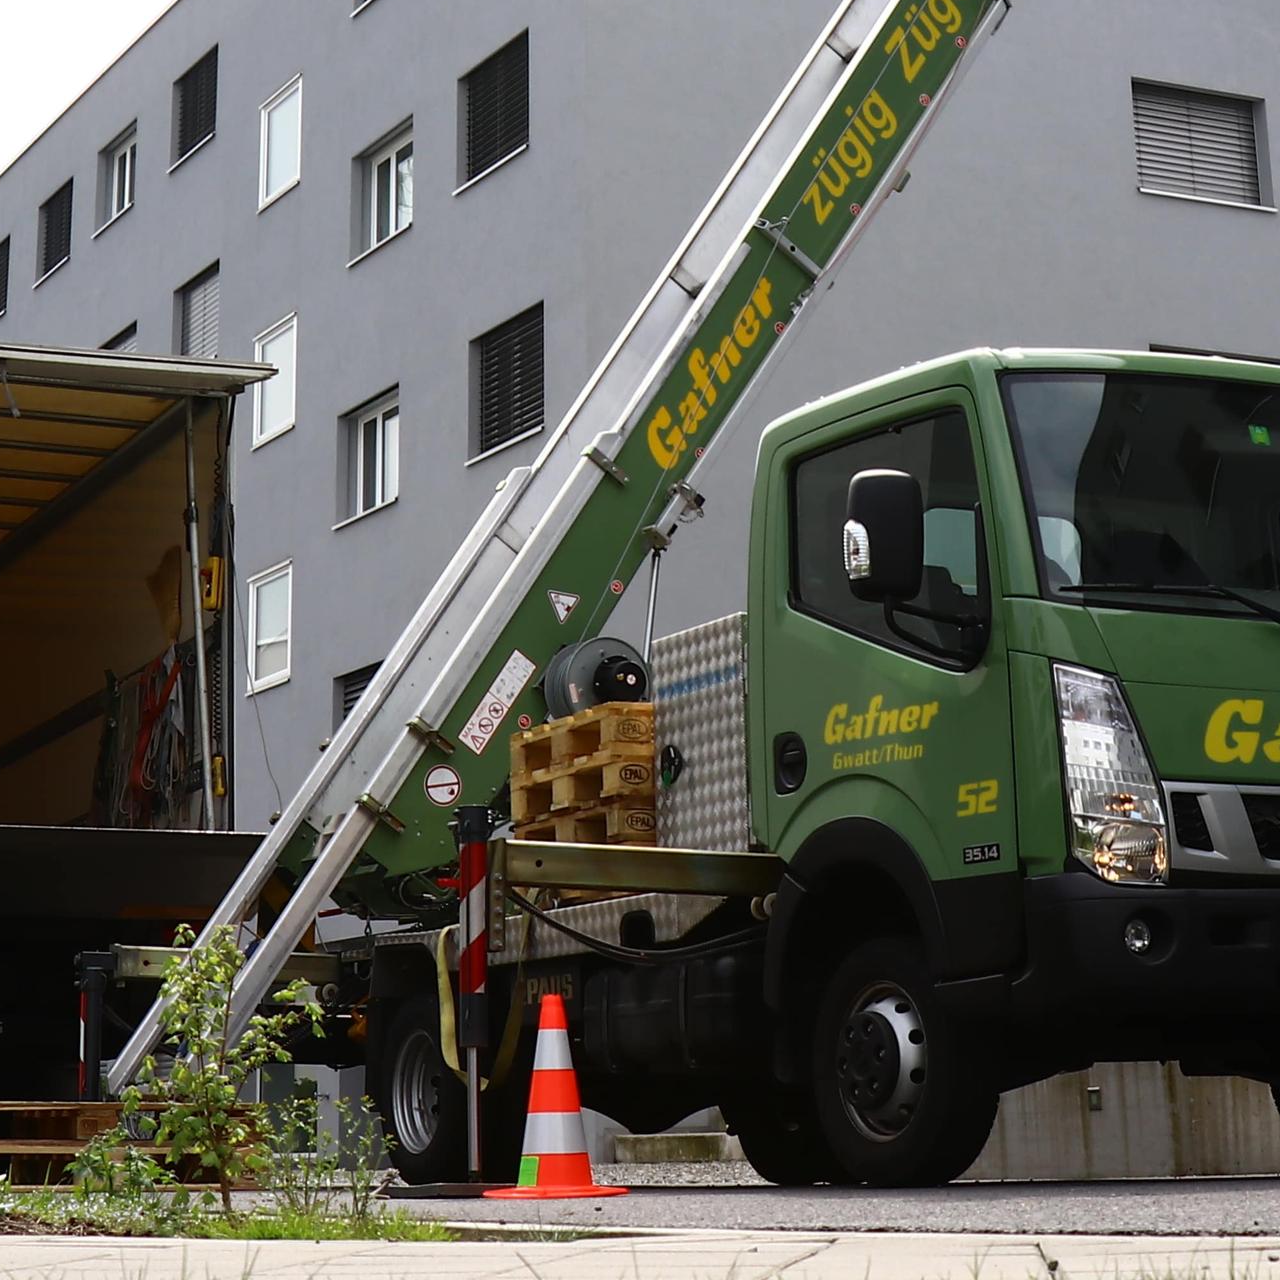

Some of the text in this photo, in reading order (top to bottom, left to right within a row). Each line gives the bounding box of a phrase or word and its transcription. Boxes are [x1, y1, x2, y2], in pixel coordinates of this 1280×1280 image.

[802, 90, 897, 225] zügig
[646, 276, 772, 471] Gafner
[622, 721, 642, 734] EPAL
[824, 694, 939, 746] Gafner
[832, 743, 924, 770] Gwatt/Thun
[624, 767, 645, 781] EPAL
[957, 780, 999, 817] 52
[630, 815, 652, 829] EPAL
[964, 845, 999, 862] 35.14
[526, 974, 573, 1005] PAUS
